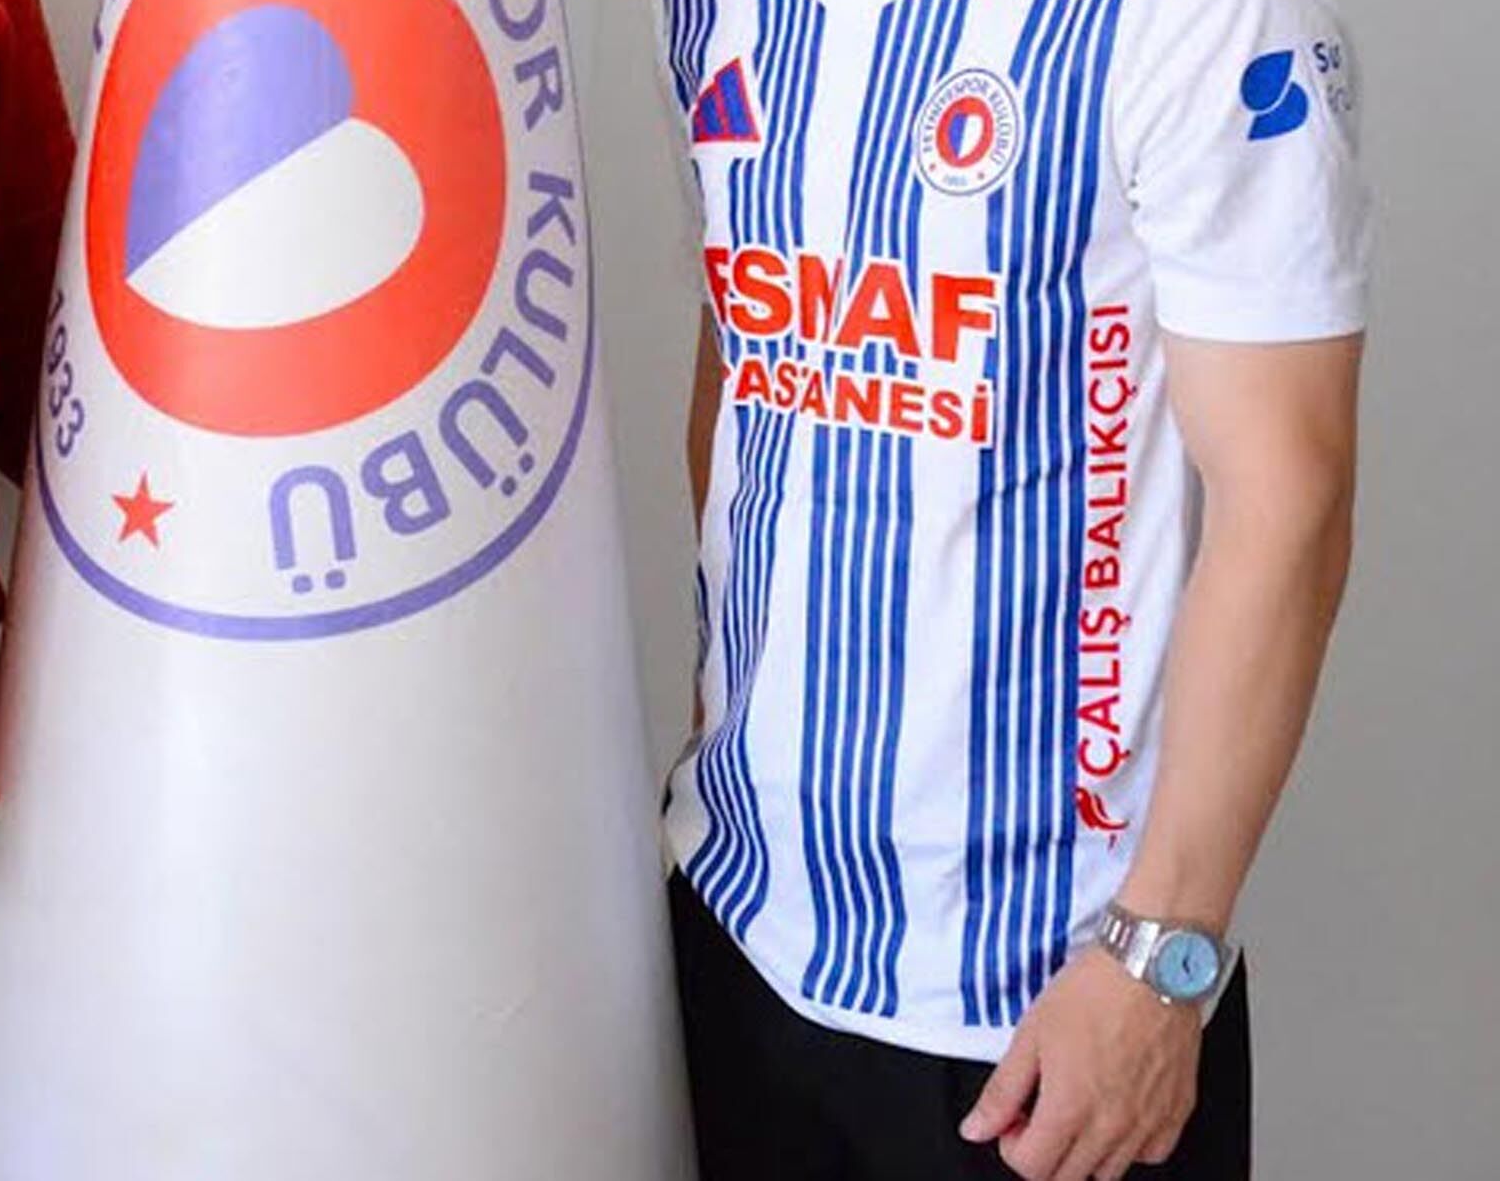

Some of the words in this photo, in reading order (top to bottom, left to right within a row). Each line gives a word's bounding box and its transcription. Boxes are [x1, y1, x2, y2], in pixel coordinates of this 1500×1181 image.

[269, 171, 575, 594] KULÜBÜ
[1084, 304, 1136, 592] BALIKÇISI
[1078, 606, 1130, 779] ÇALIŞ
